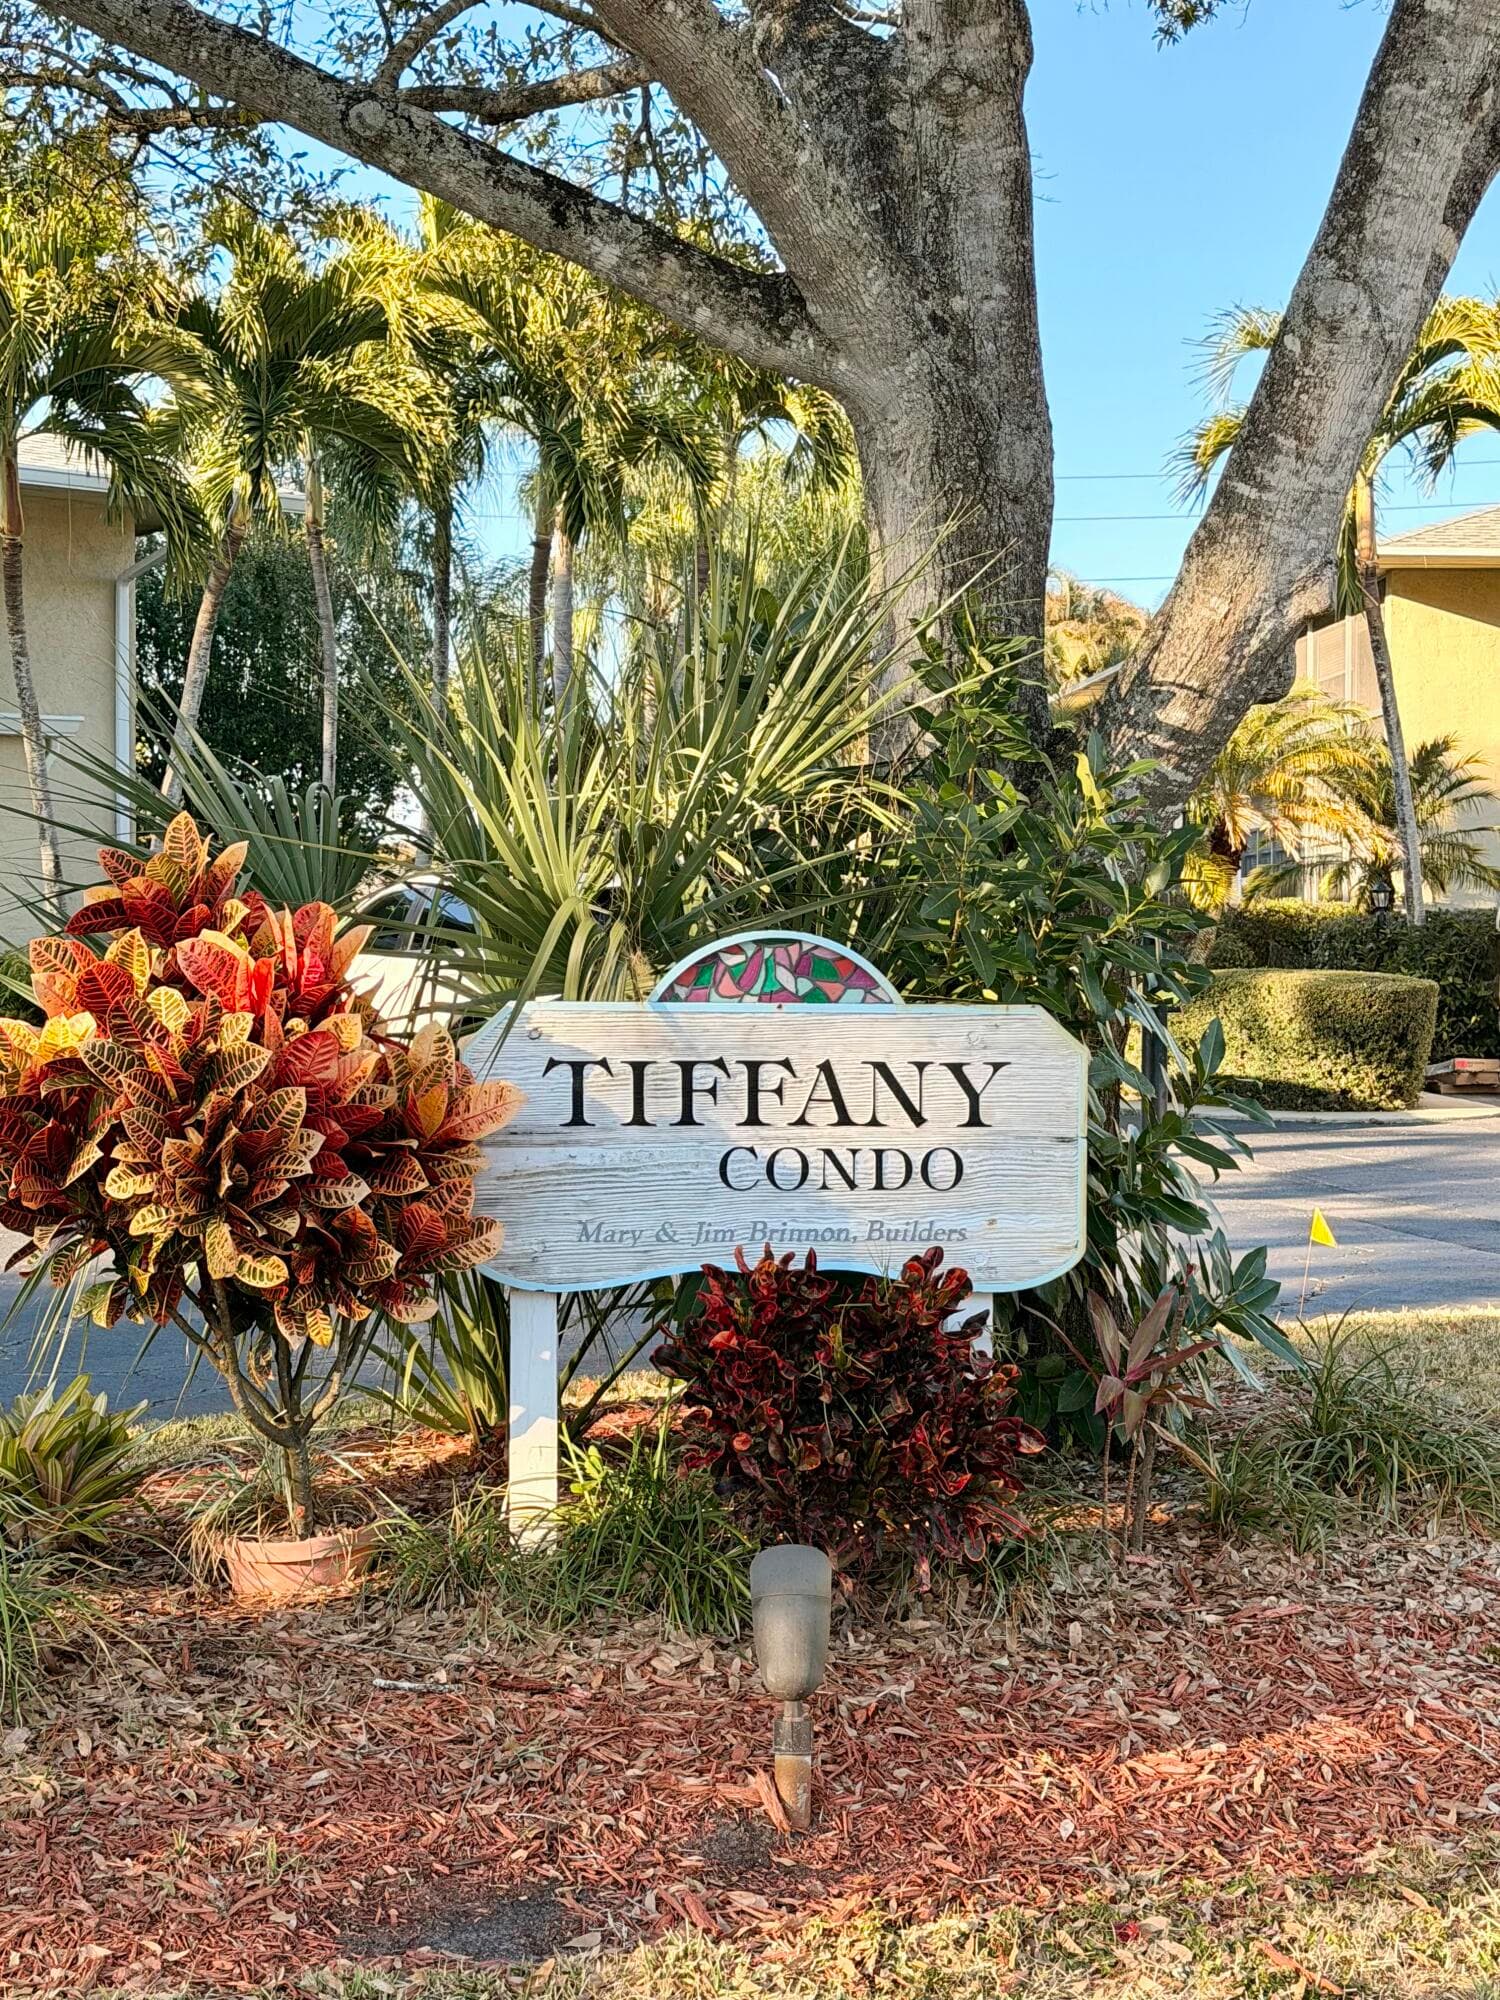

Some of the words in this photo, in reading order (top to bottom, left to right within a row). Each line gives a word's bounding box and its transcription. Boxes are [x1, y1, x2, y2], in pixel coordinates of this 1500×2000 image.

[542, 1056, 1011, 1128] TIFFANY
[719, 1146, 964, 1192] CONDO
[577, 1220, 642, 1246] Mary
[655, 1221, 680, 1243] &
[690, 1221, 735, 1247] Jim
[749, 1220, 858, 1243] Brinnon,
[866, 1220, 968, 1242] Builders
